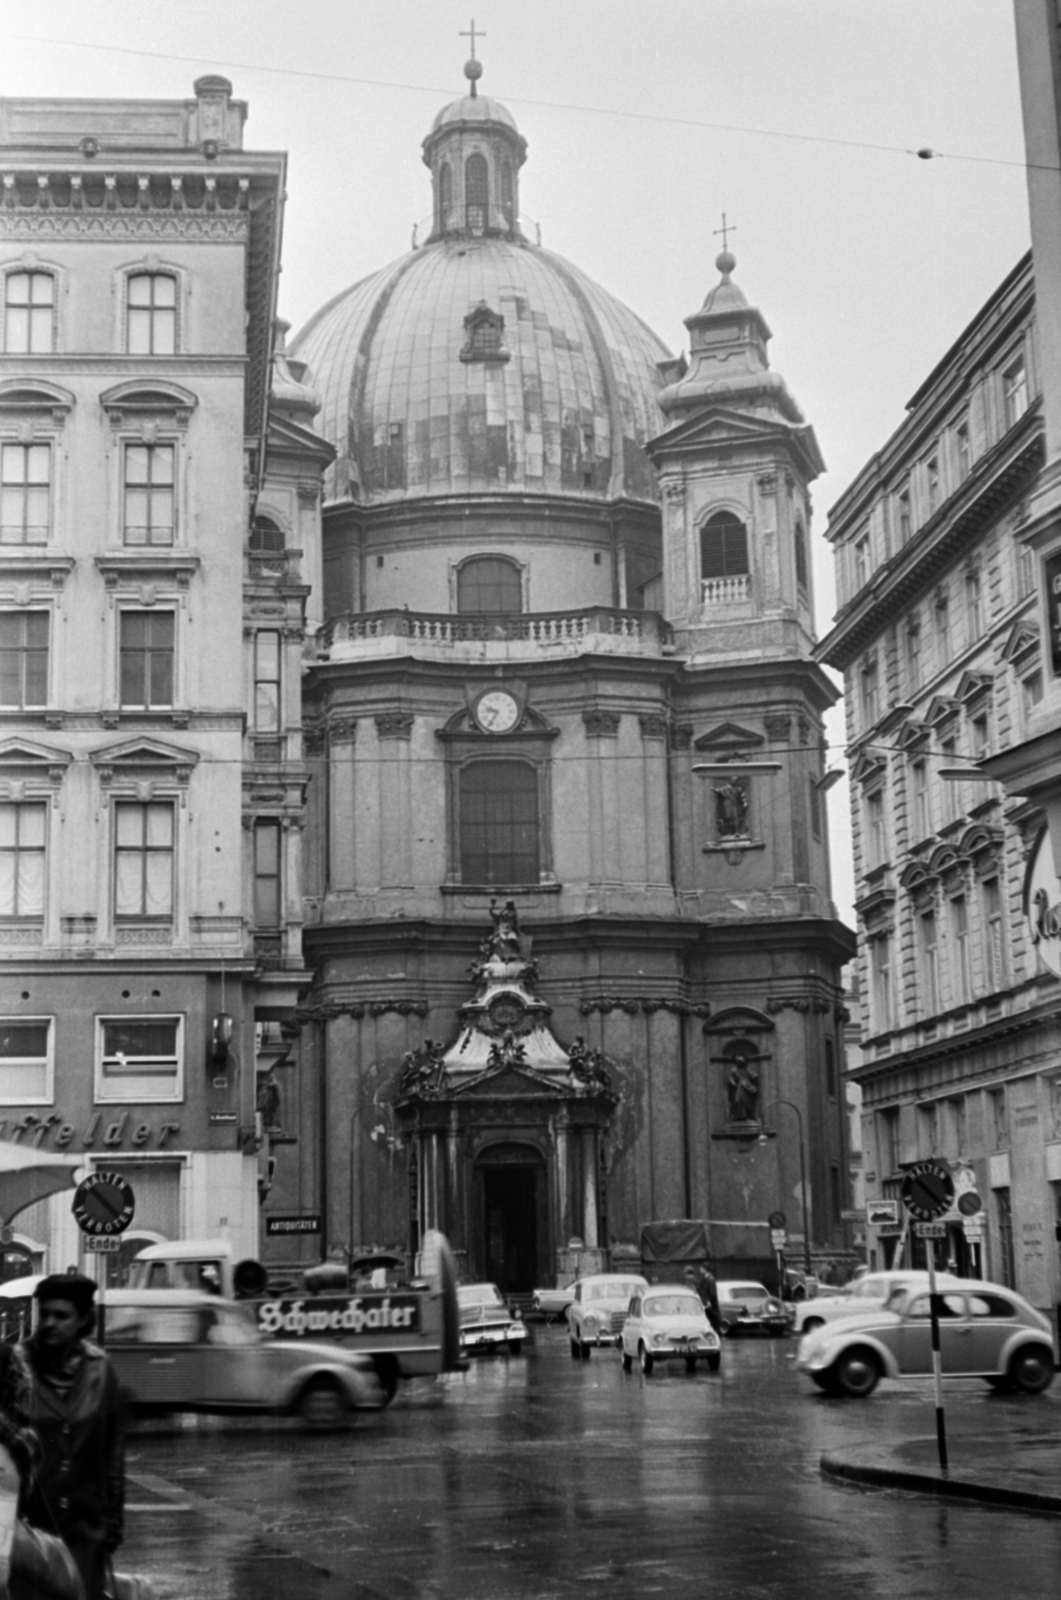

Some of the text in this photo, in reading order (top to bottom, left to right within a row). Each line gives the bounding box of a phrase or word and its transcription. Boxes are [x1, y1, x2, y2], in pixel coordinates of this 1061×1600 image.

[0, 1112, 180, 1148] ffelder
[83, 1172, 127, 1190] HALTEN
[909, 1163, 946, 1181] HALTEN
[904, 1195, 954, 1219] VERBOTEN
[75, 1206, 133, 1232] VERBOTEN
[270, 1218, 318, 1231] ANTIQUITÄTEN
[89, 1236, 116, 1250] Ende
[258, 1298, 416, 1336] Schwechater
